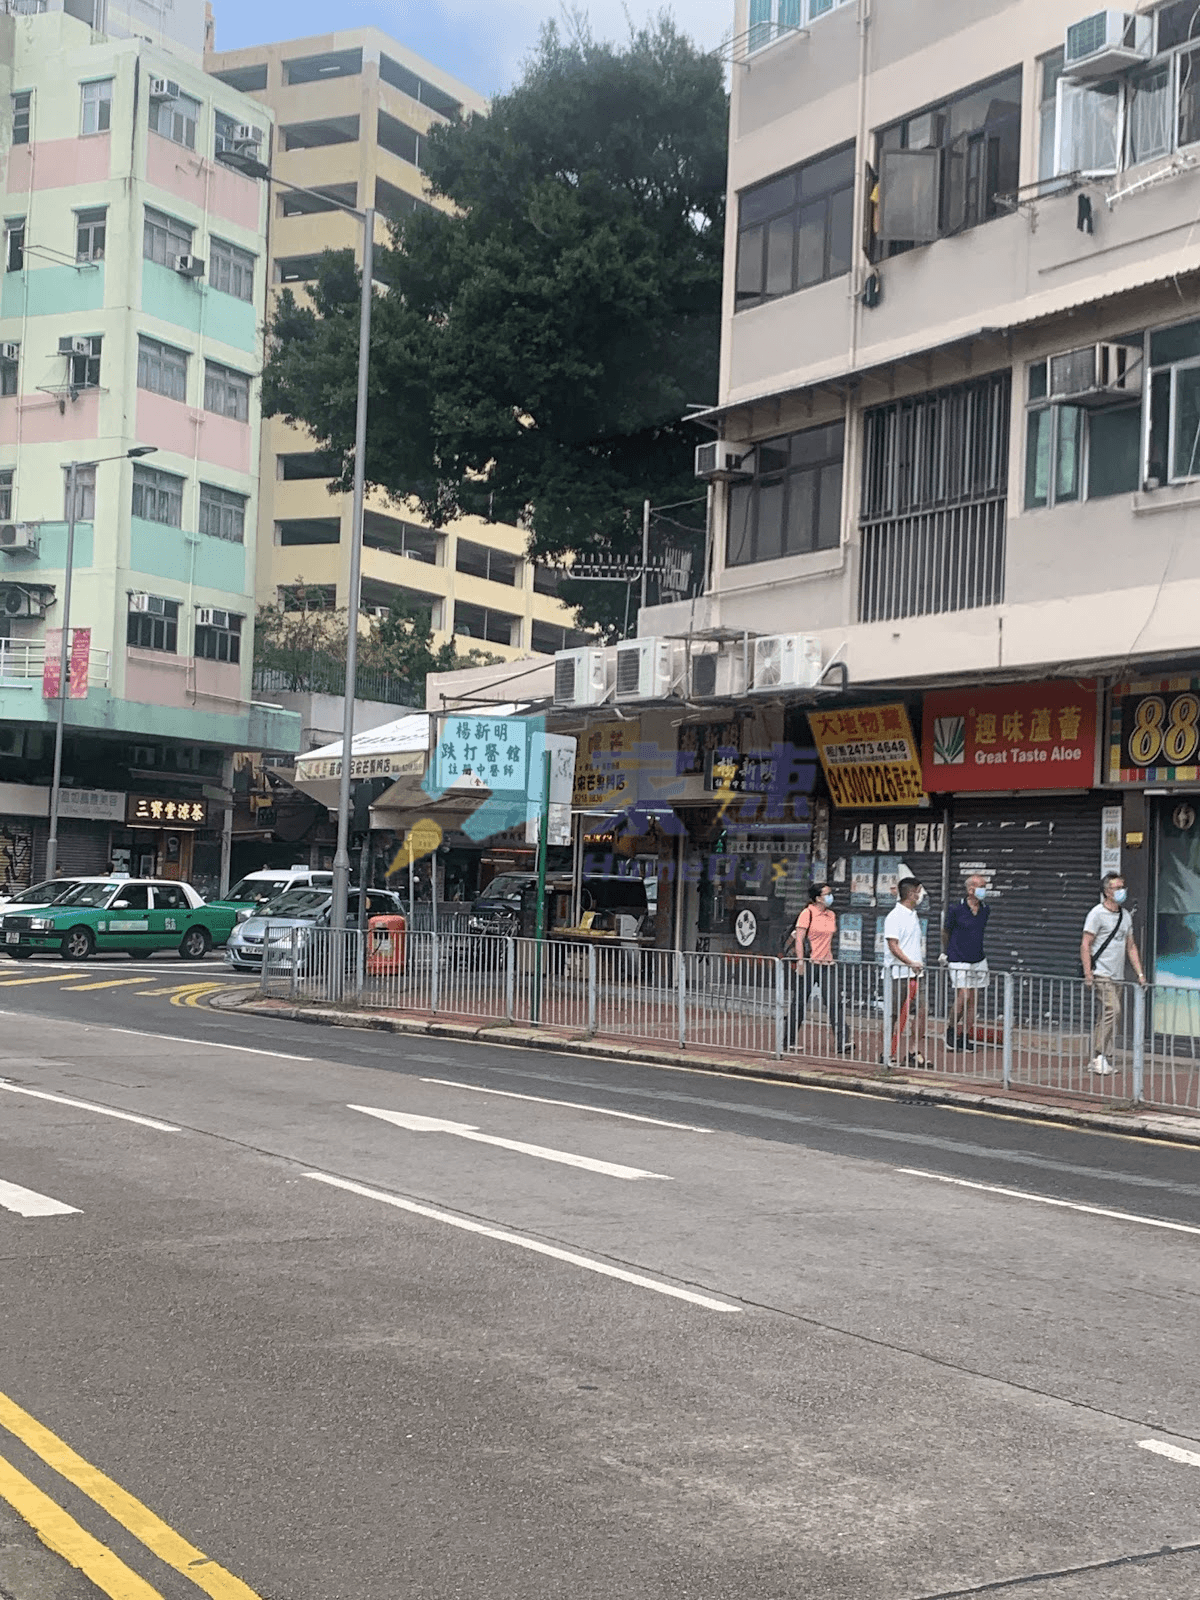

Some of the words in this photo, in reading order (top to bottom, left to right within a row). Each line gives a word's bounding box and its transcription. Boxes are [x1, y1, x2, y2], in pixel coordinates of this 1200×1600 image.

[456, 722, 508, 742] 楊新明
[975, 705, 1081, 743] 趣味蘆薈
[441, 742, 521, 762] 跌打醫館
[847, 743, 874, 755] 2473
[975, 749, 1007, 765] Great
[1010, 748, 1048, 763] Taste
[1051, 746, 1082, 761] Aloe
[448, 763, 514, 777] 註冊中醫師
[828, 765, 898, 803] 91300226
[896, 828, 905, 841] 91
